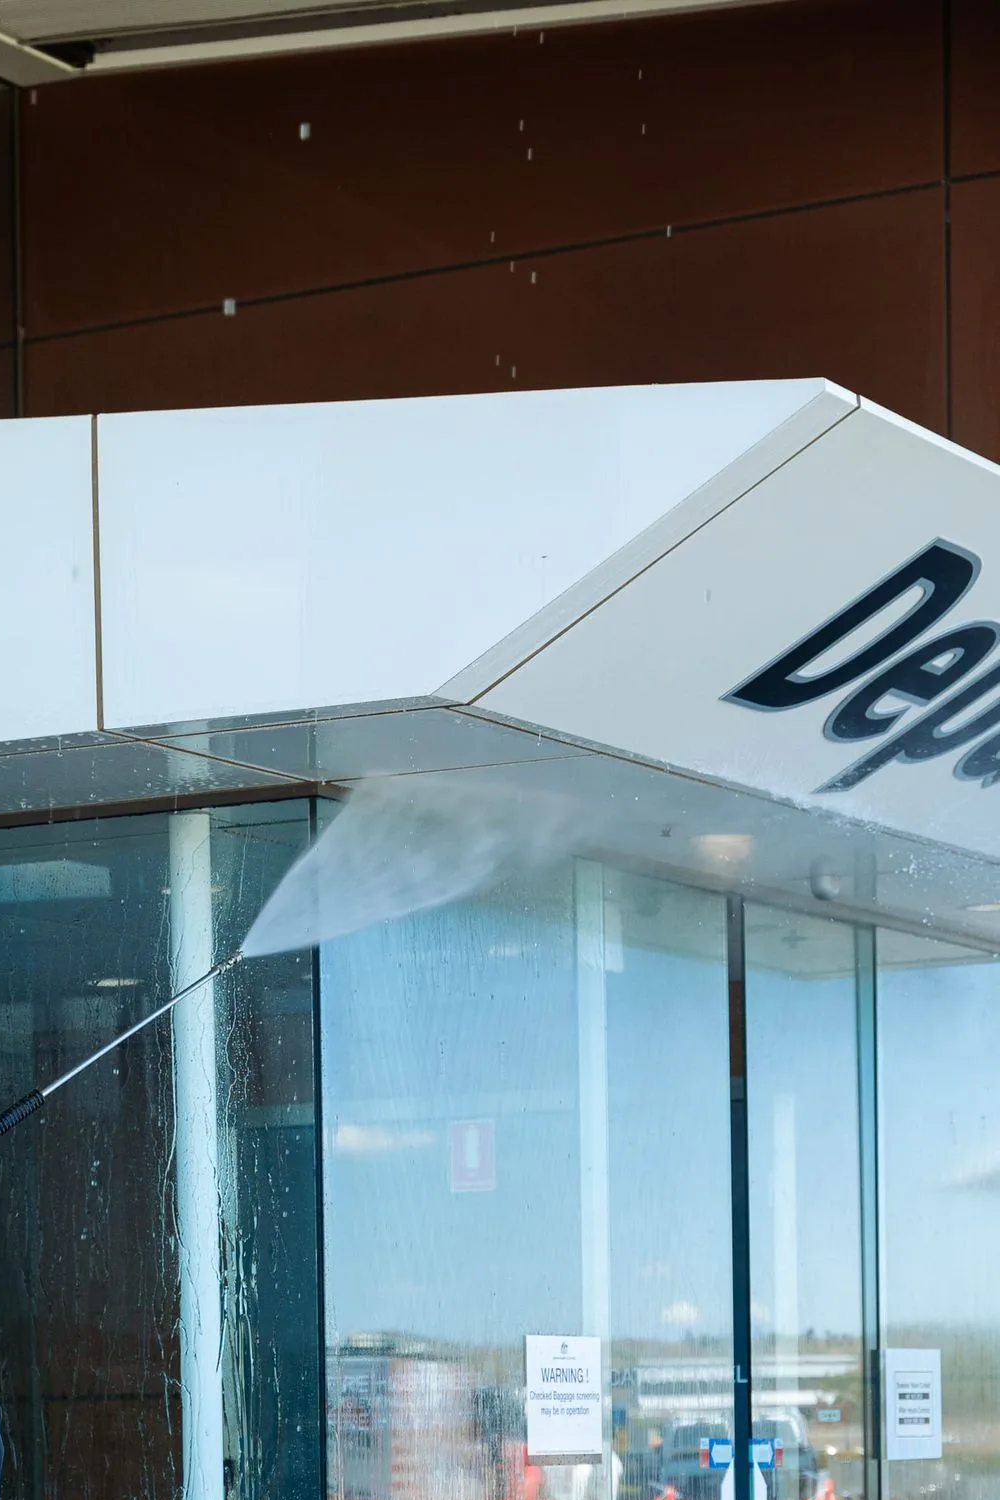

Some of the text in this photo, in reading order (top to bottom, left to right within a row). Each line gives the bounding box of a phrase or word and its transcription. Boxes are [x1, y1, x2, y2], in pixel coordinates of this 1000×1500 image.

[718, 536, 1000, 793] Dep
[541, 1367, 584, 1384] WARNING
[529, 1390, 600, 1403] Checked Baggage screening
[540, 1405, 590, 1417] may be in operation
